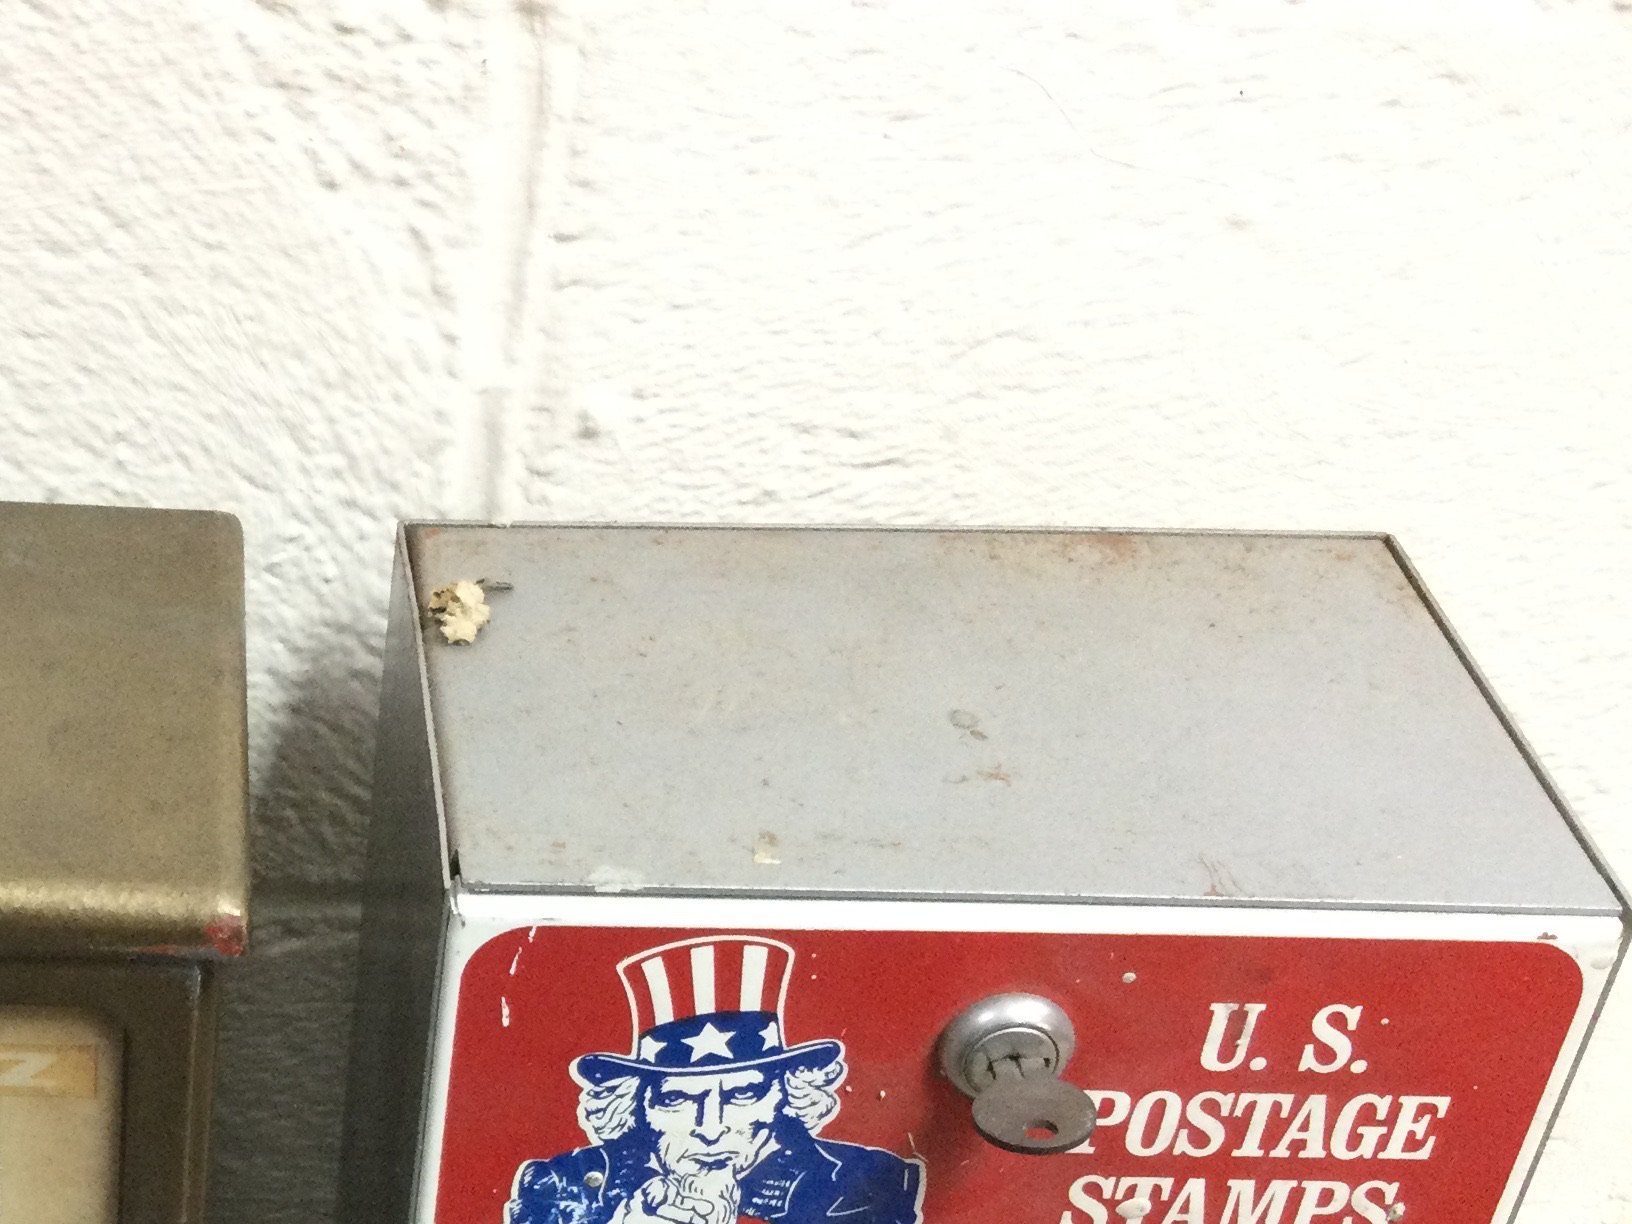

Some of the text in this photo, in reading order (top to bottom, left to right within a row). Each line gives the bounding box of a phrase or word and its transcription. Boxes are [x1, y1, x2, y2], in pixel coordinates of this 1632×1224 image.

[1199, 1001, 1369, 1075] U. S.
[1065, 1088, 1452, 1161] POSTAGE
